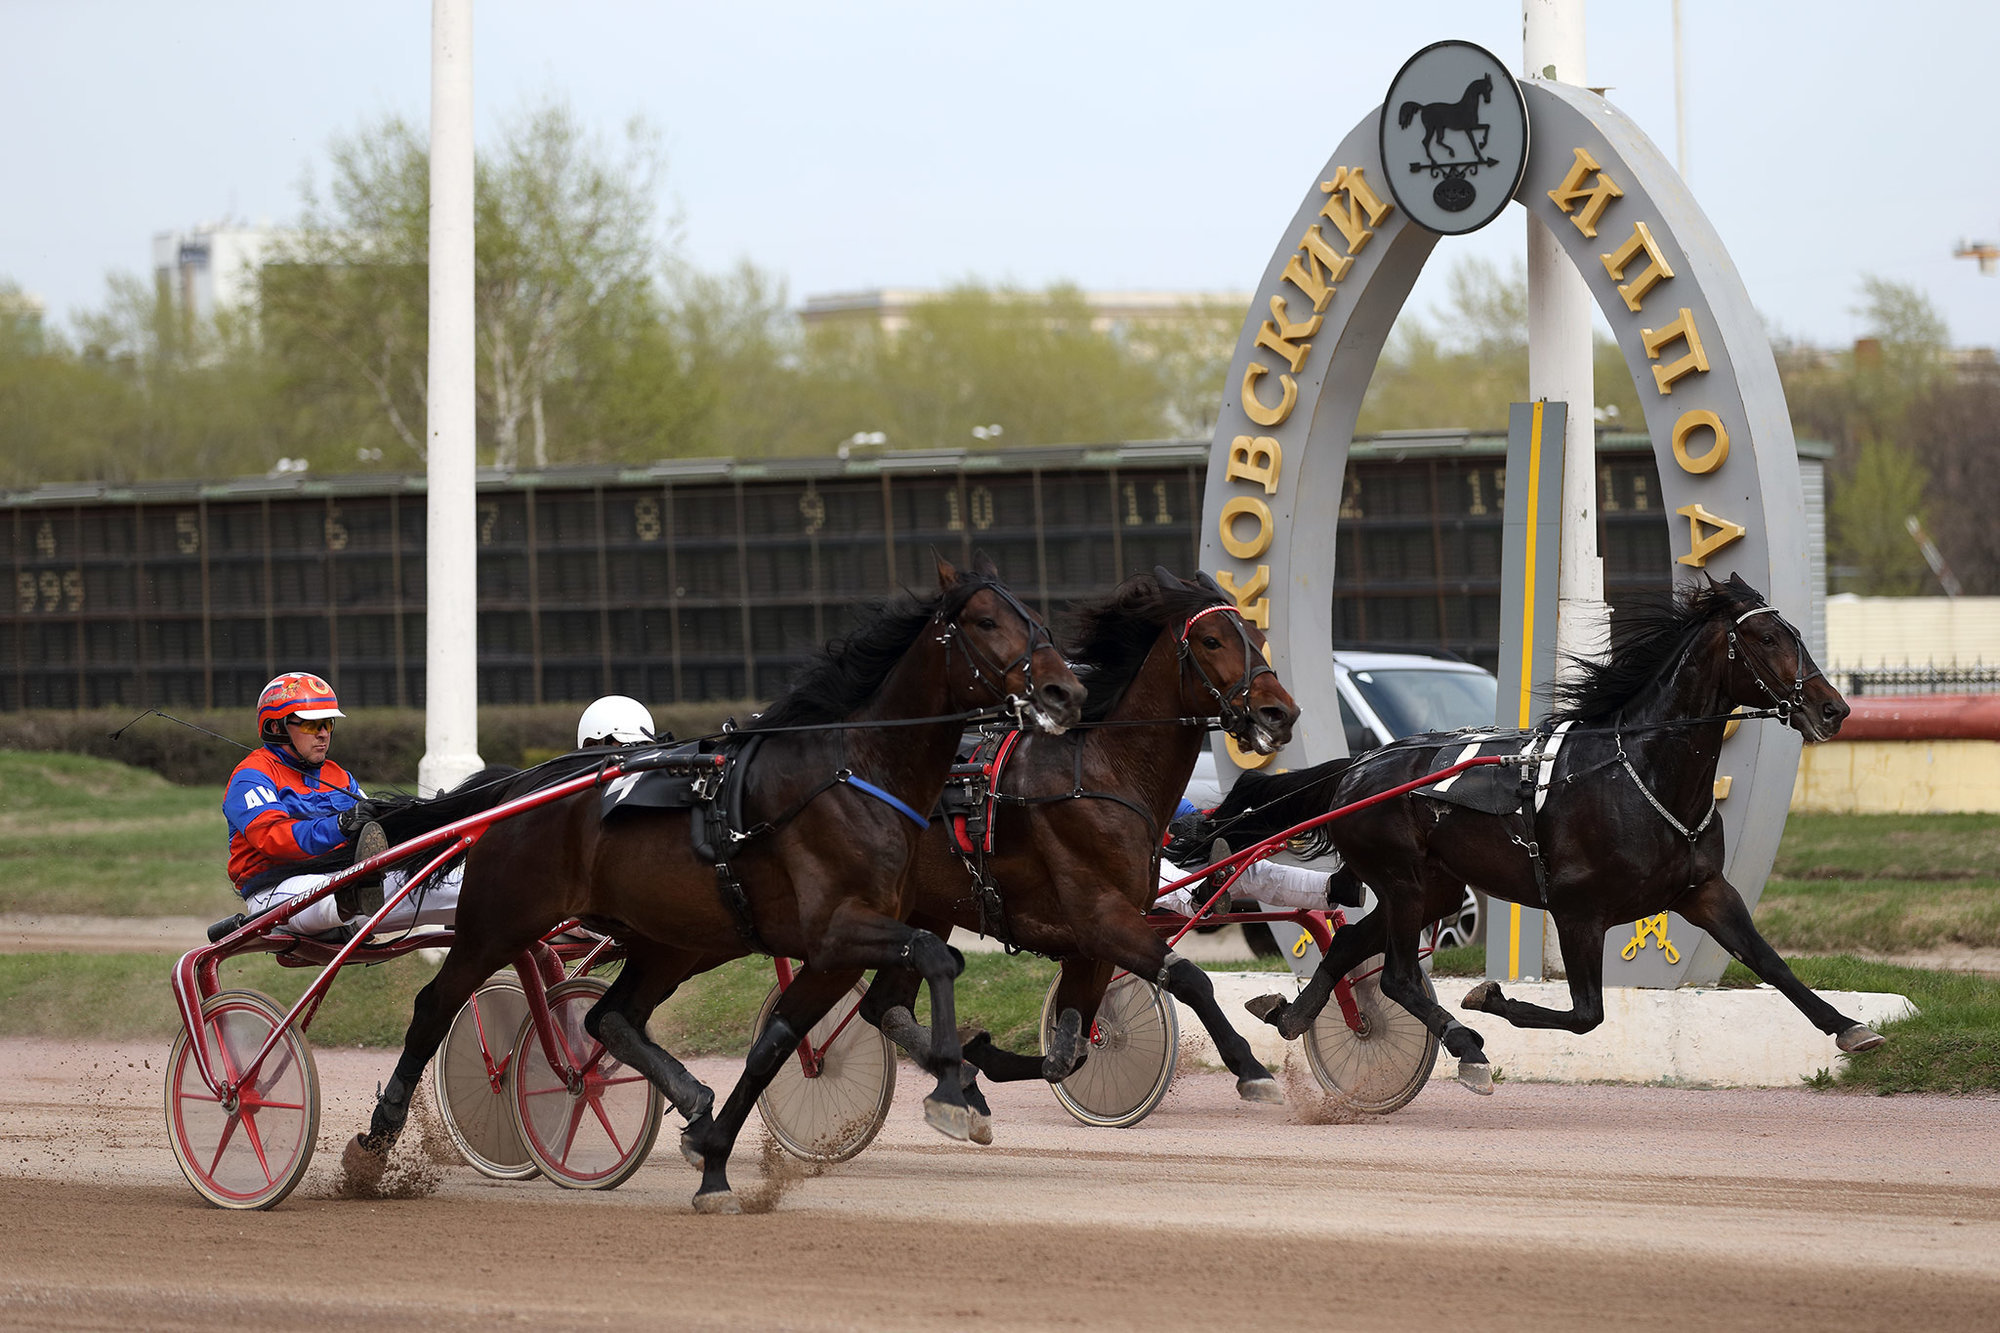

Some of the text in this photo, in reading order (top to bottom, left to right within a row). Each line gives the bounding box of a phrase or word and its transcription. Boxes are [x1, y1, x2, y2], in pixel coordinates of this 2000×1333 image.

[36, 516, 57, 558] 4
[175, 511, 200, 554] 5
[634, 496, 661, 541] 8
[799, 488, 825, 535] 9
[944, 485, 995, 531] 10
[1122, 479, 1174, 525] 11
[1216, 166, 1394, 846] КОВСКИЙ
